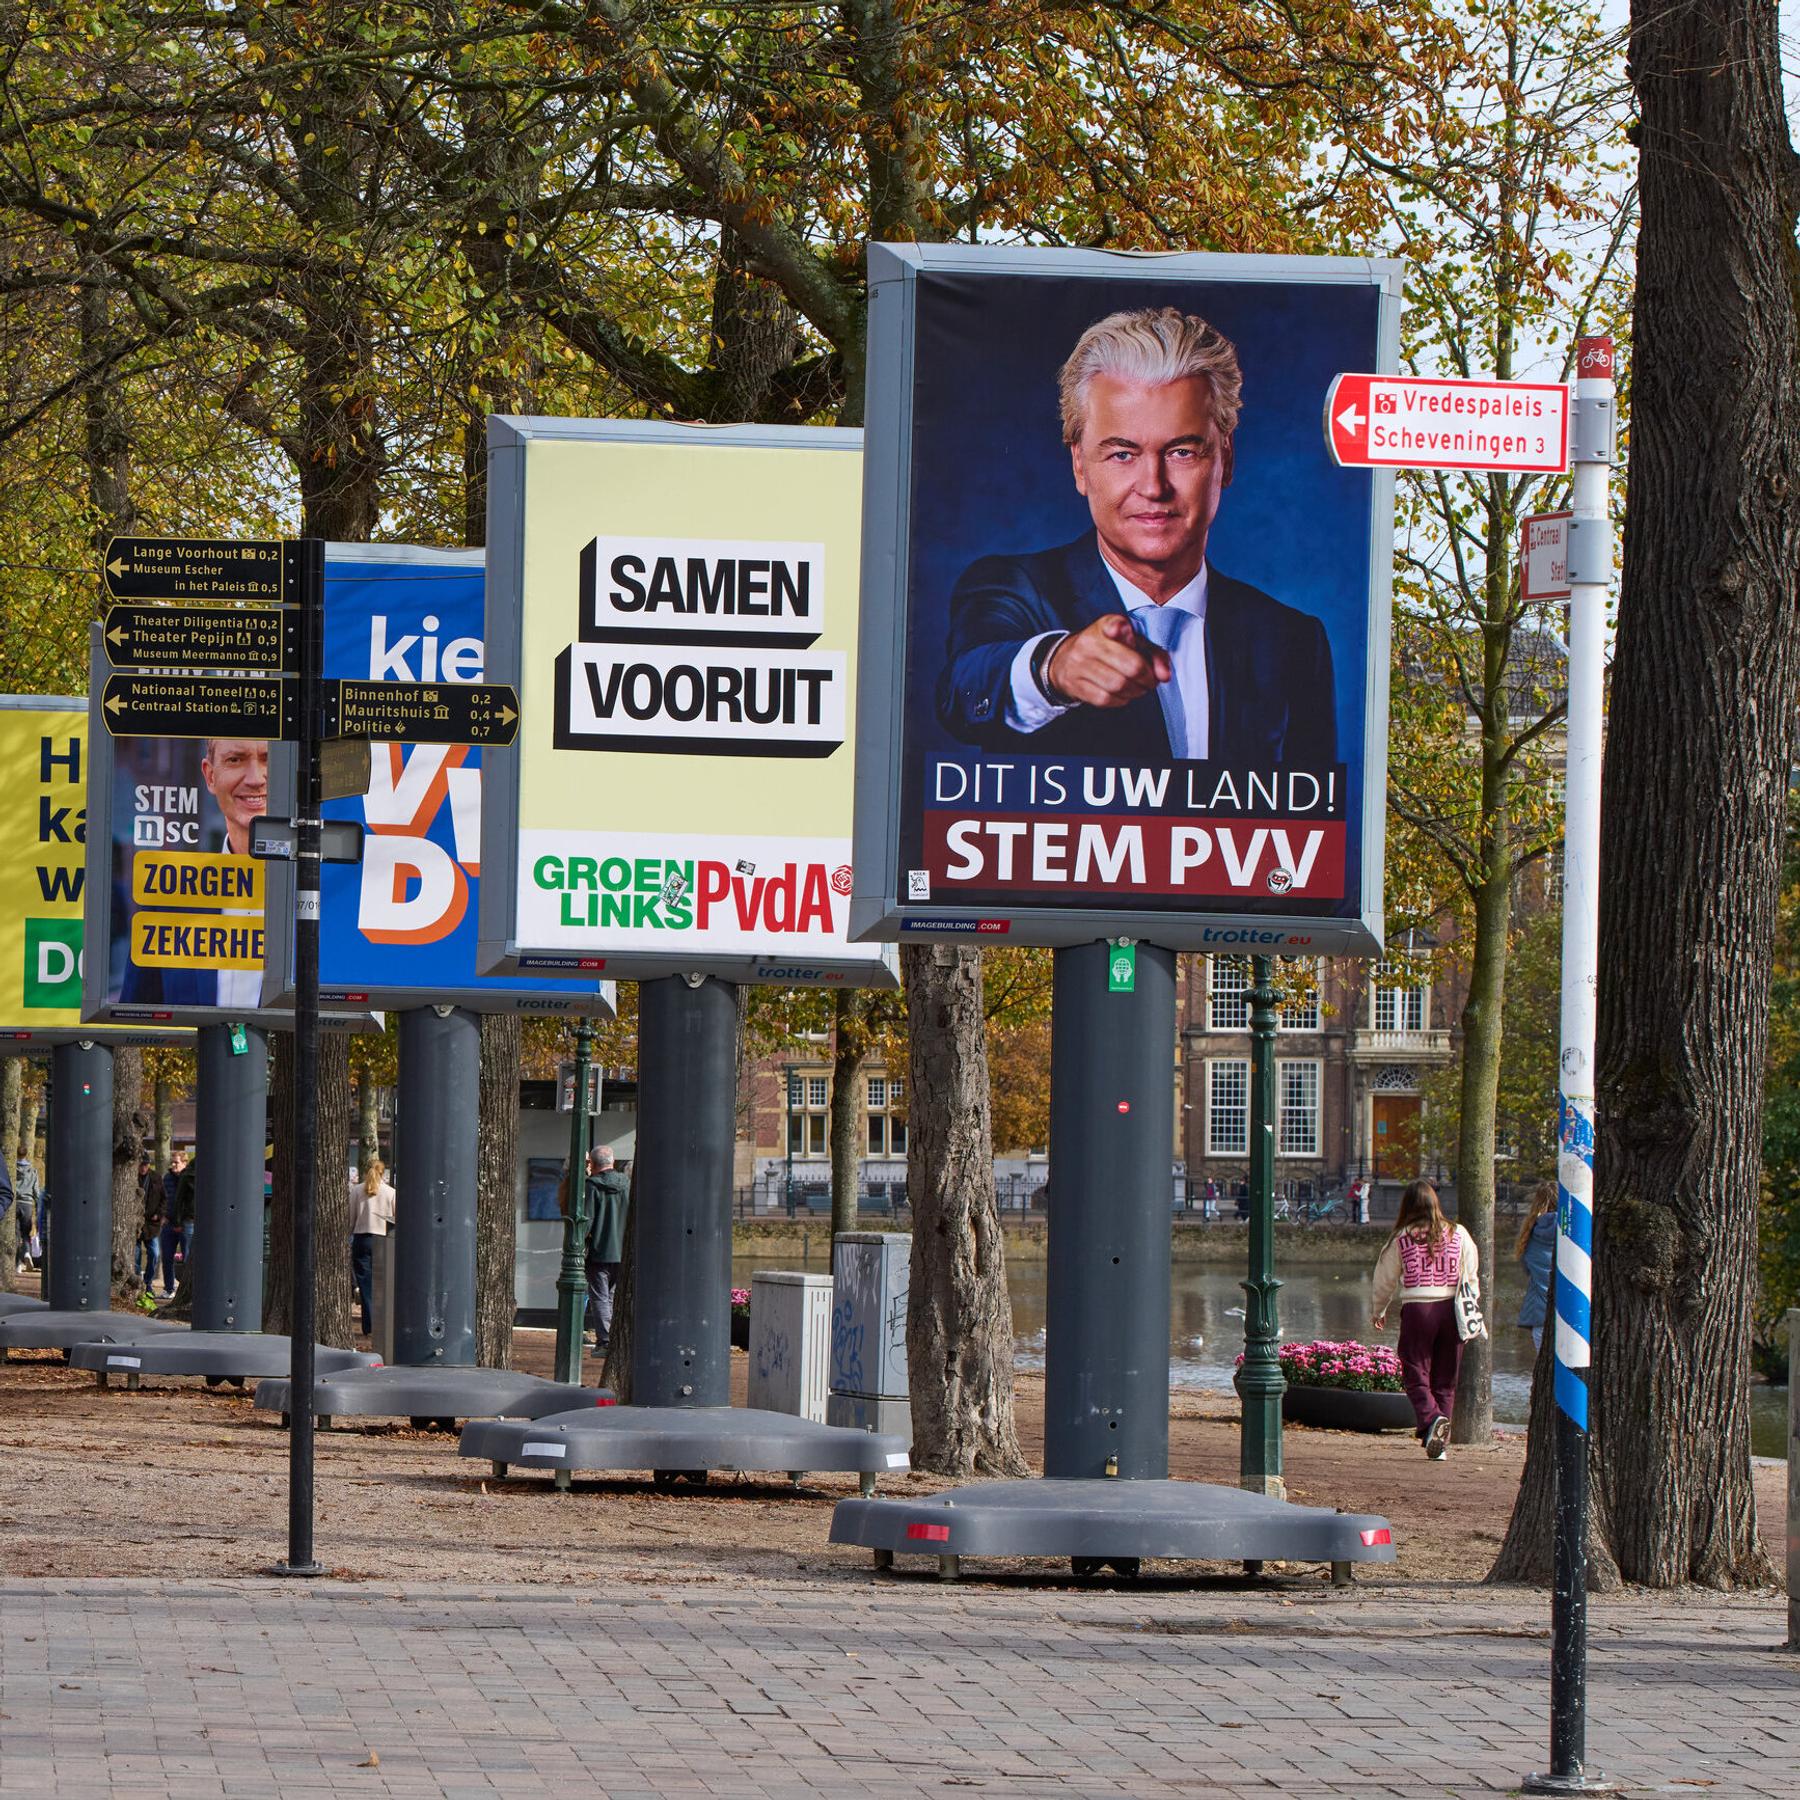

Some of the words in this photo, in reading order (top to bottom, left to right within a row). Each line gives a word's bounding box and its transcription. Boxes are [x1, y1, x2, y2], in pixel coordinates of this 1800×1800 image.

[1403, 389, 1543, 418] Vredespaleis
[1373, 426, 1527, 459] Scheveningen
[1535, 437, 1545, 454] 3
[133, 545, 173, 561] Lange
[176, 546, 239, 561] Voorhout
[258, 550, 278, 562] 0,2
[133, 563, 181, 575] Museum
[185, 564, 224, 576] Escher
[175, 579, 186, 591] in
[189, 580, 209, 592] het
[211, 581, 246, 593] Paleis
[261, 583, 278, 594] 0,5
[609, 555, 810, 617] SAMEN
[133, 615, 181, 627] Theater
[183, 616, 243, 630] Diligentia
[259, 619, 278, 630] 0,2
[133, 629, 187, 643] Theater
[191, 631, 234, 646] Pepijn
[257, 635, 278, 647] 0,9
[133, 648, 179, 660] Museum
[182, 649, 247, 661] Meermanno
[261, 652, 278, 662] 0,9
[131, 683, 195, 696] Nationaal
[199, 685, 242, 698] Toneel
[259, 689, 277, 699] 0,6
[345, 688, 419, 702] Binnenhof
[471, 694, 491, 706] 0,2
[584, 662, 833, 725] VOORUIT
[131, 700, 182, 712] Centraal
[185, 701, 228, 714] Station
[259, 704, 277, 715] 1,2
[345, 704, 430, 719] Mauritshuis
[470, 709, 490, 722] 0,4
[344, 720, 391, 734] Politie
[471, 726, 490, 738] 0,7
[135, 784, 198, 814] STEM
[935, 762, 1014, 804] DIT
[1029, 765, 1067, 805] IS
[1083, 767, 1171, 808] UW
[1187, 770, 1335, 812] LAND!
[135, 818, 199, 844] nsc
[945, 820, 1147, 884] STEM
[1170, 827, 1325, 888] PVV
[143, 864, 254, 898] ZORGEN
[533, 855, 695, 893] GROEN
[696, 860, 835, 933] PvdA
[561, 892, 693, 930] LINKS
[142, 925, 264, 960] ZEKERHE
[38, 941, 83, 984] D
[1404, 1256, 1458, 1273] CLUB
